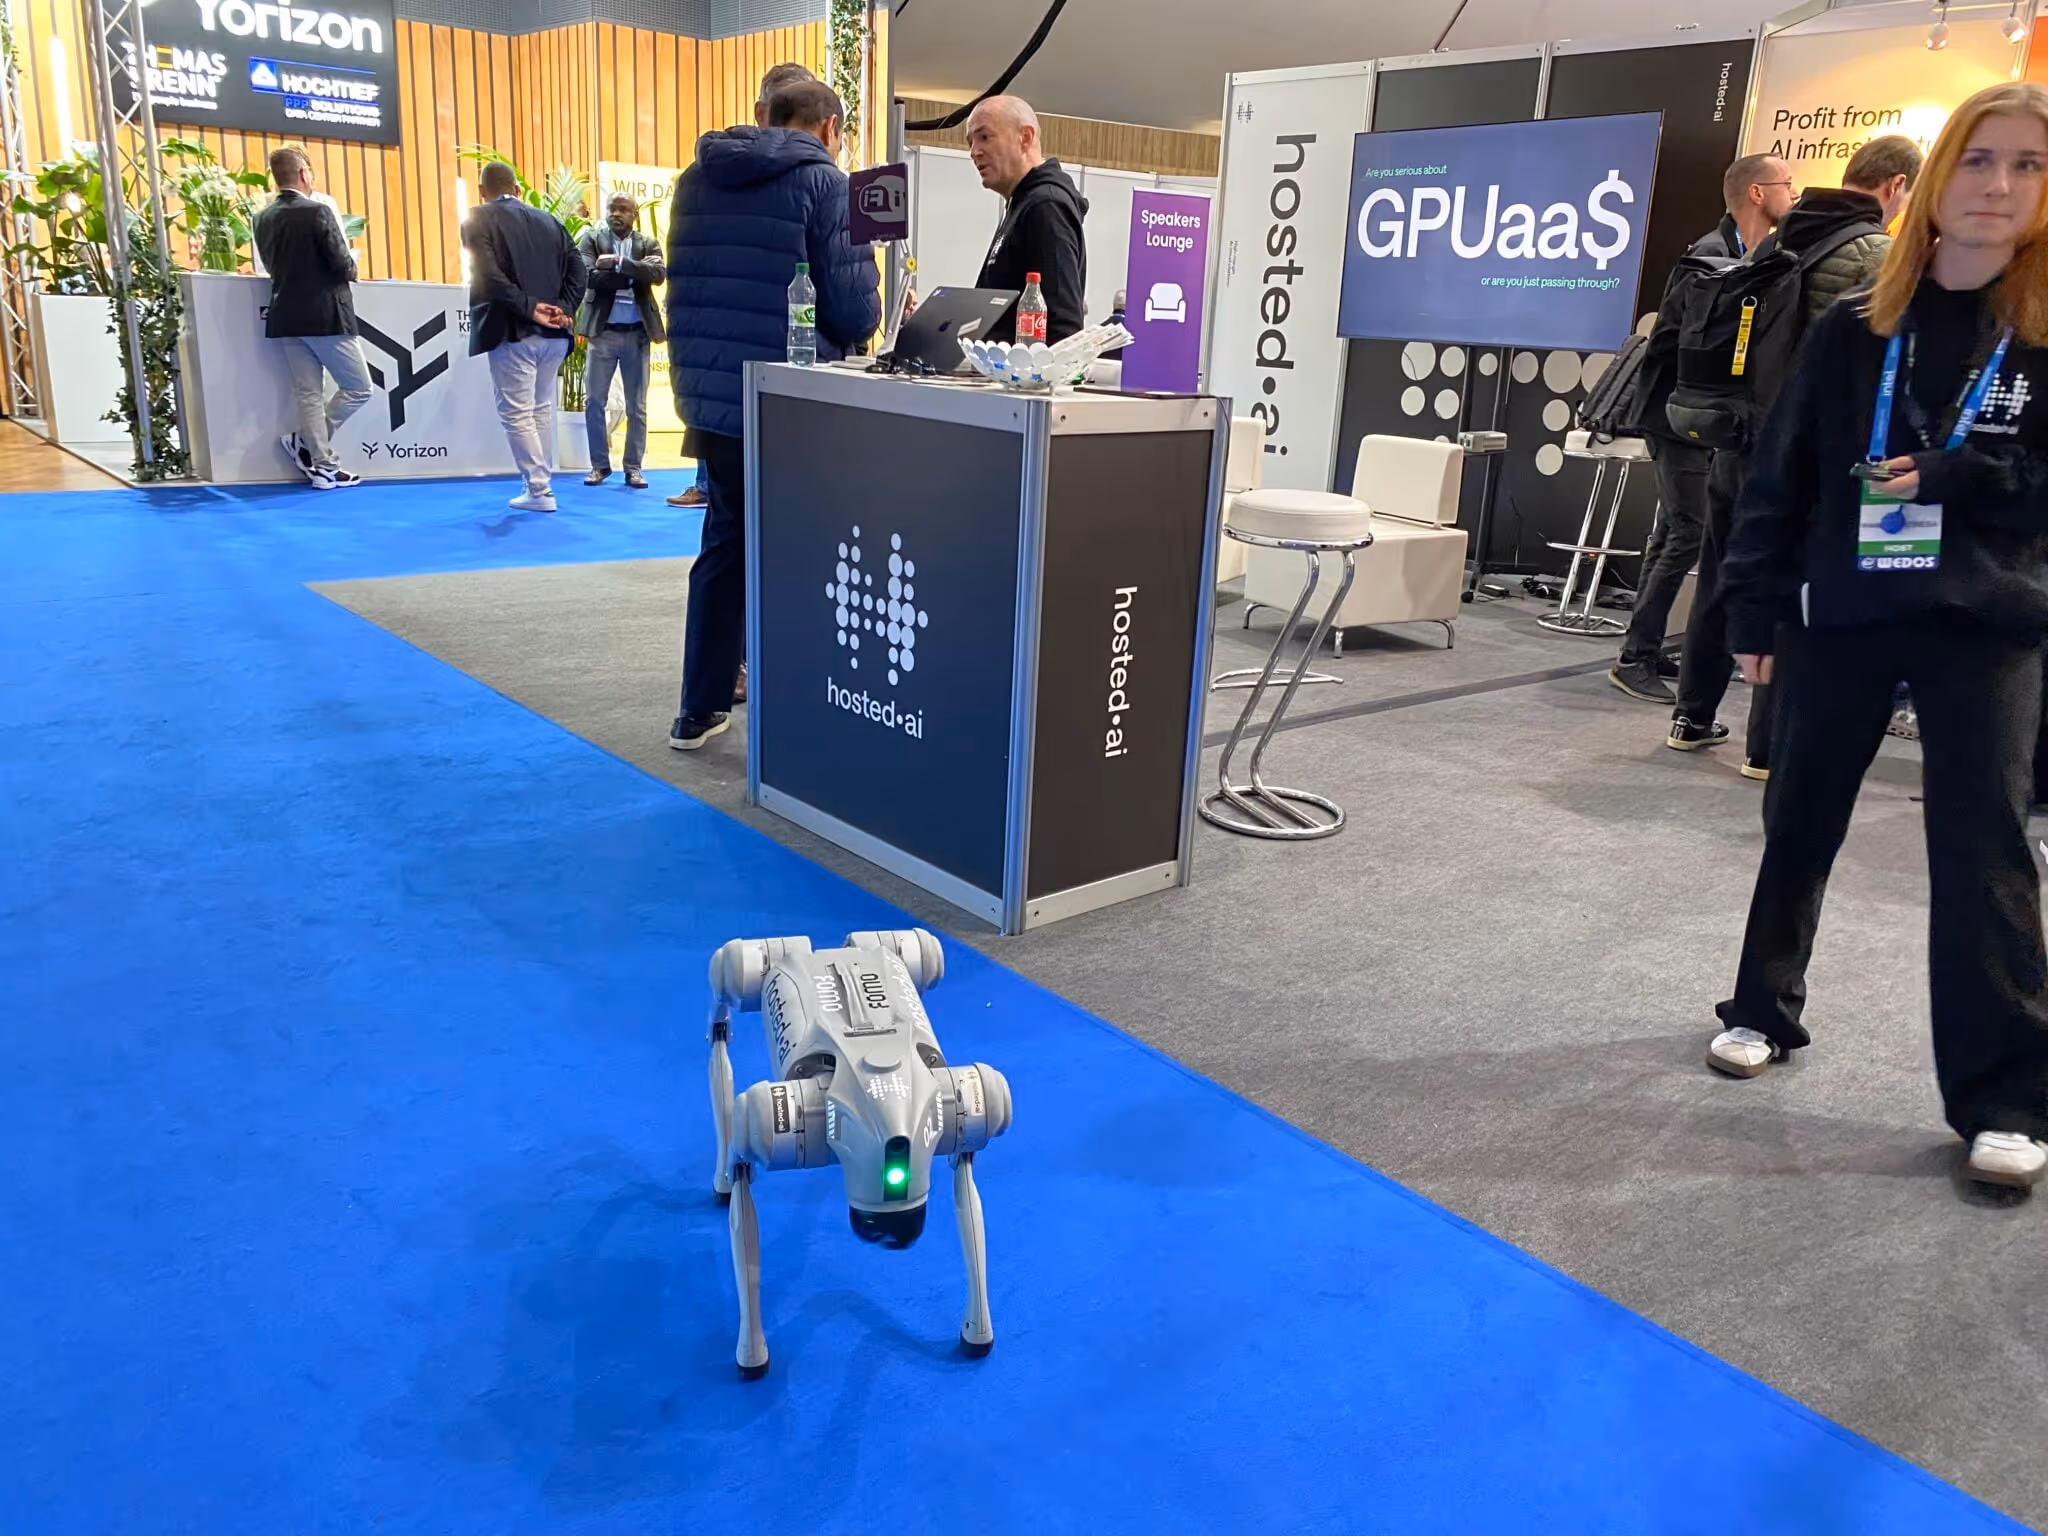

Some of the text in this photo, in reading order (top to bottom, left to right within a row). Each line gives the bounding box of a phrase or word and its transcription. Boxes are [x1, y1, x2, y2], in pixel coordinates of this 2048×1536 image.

[196, 0, 383, 53] Yorizon
[281, 73, 380, 102] HOCHTIEF
[1772, 105, 1902, 131] Profit from
[1770, 138, 1792, 160] AI
[1365, 164, 1448, 179] Are you serious about
[613, 180, 647, 198] WIR
[1141, 209, 1201, 229] Speakers
[1358, 169, 1634, 270] GPUaa$
[1146, 231, 1194, 253] Lounge
[1481, 276, 1620, 291] or are you just passing through?
[385, 443, 448, 459] Yorizon
